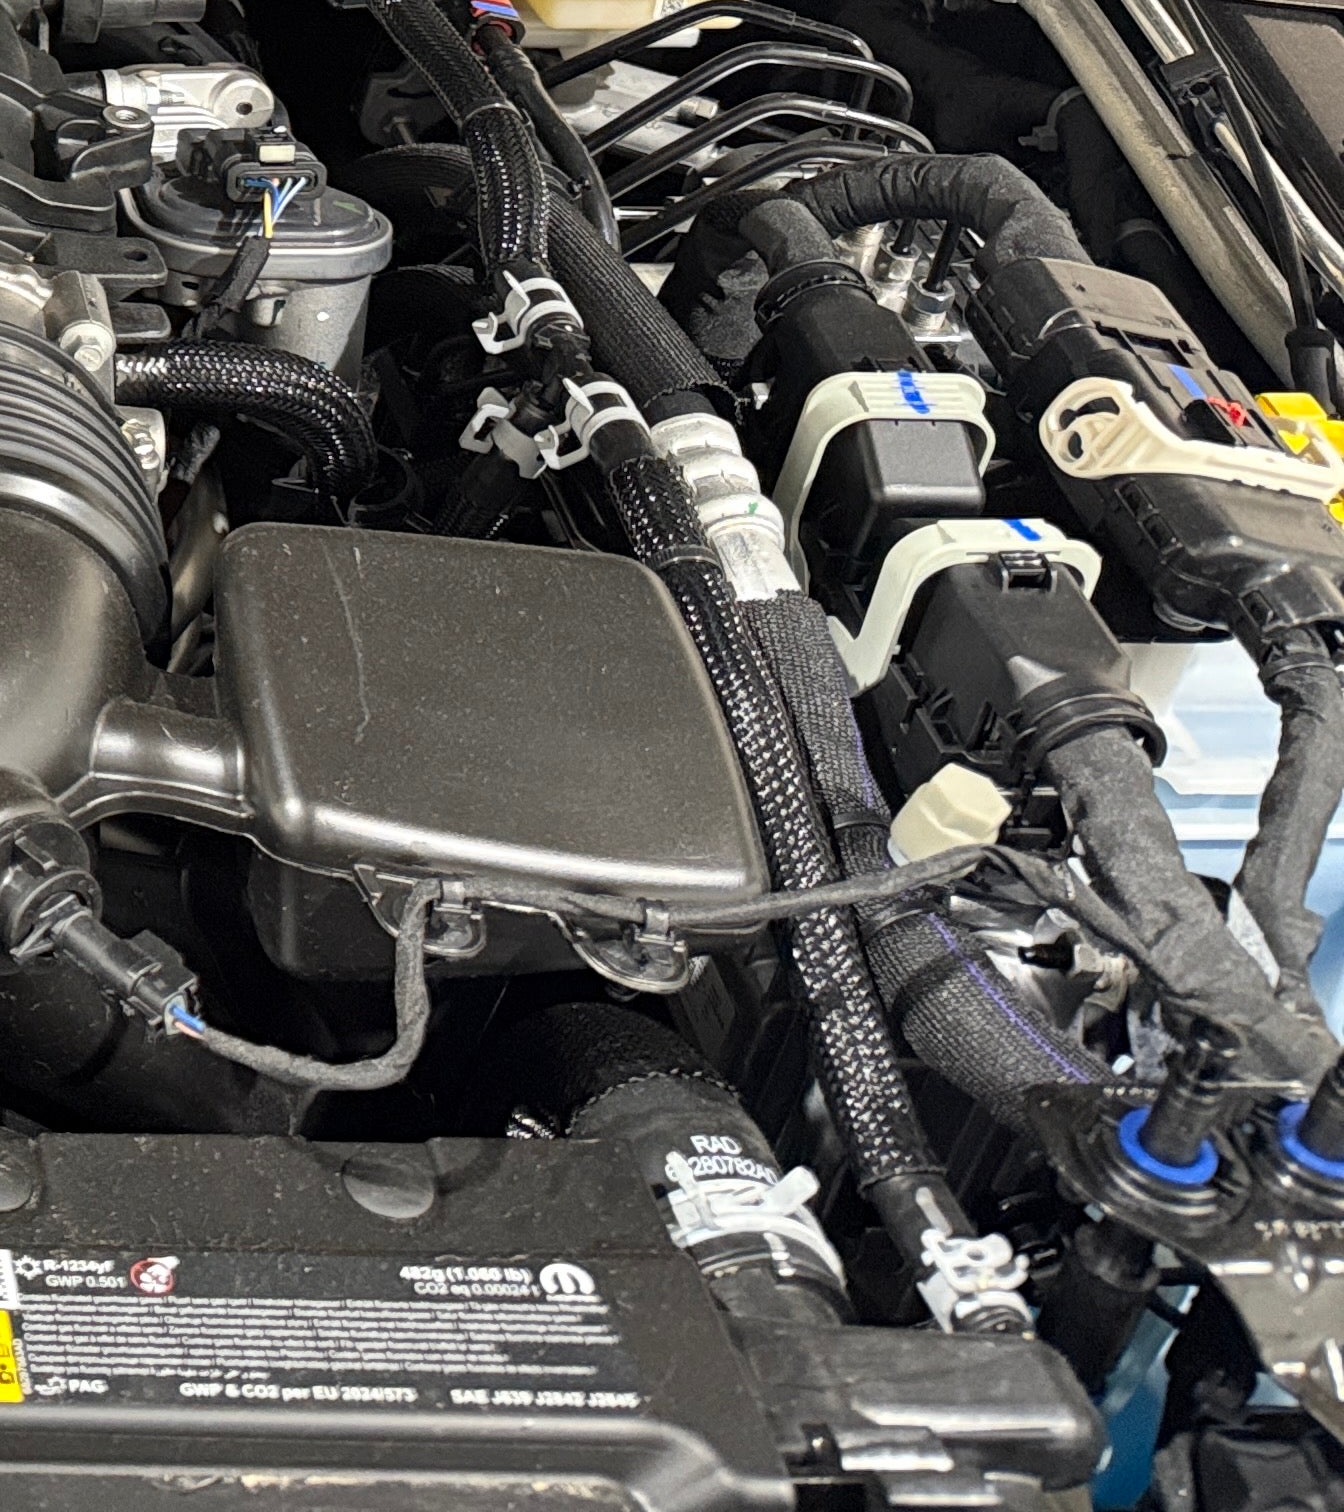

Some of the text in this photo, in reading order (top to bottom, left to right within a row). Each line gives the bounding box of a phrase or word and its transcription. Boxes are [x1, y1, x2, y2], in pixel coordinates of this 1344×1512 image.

[689, 1134, 742, 1155] RAD
[665, 1155, 779, 1186] 6280782AD
[45, 1276, 128, 1289] GWP 0.501
[414, 1281, 449, 1295] CO2
[68, 1379, 110, 1395] PAG
[179, 1382, 224, 1398] GWP
[241, 1384, 280, 1400] CO2
[281, 1386, 311, 1402] per
[312, 1385, 340, 1401] EU
